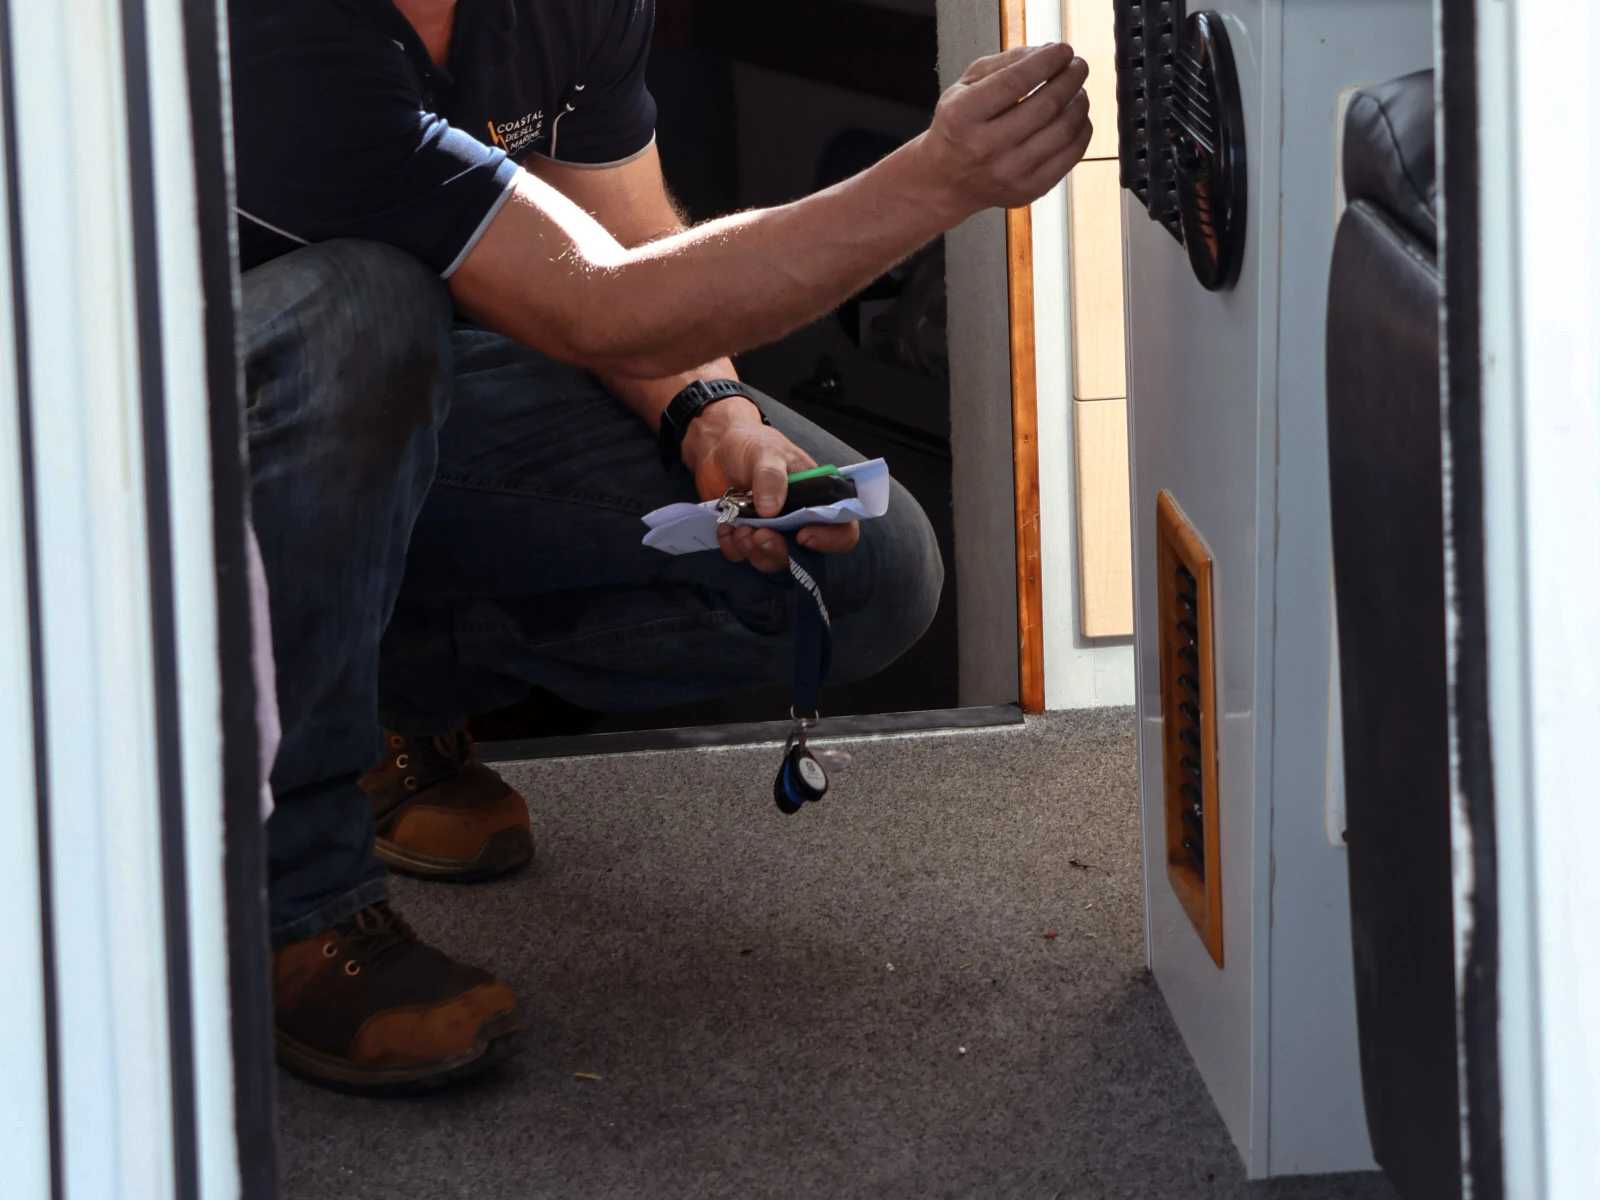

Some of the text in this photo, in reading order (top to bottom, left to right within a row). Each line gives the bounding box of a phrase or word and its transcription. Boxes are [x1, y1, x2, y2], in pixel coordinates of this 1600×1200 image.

[497, 109, 544, 134] COASTAL
[505, 124, 533, 143] DIESEL
[510, 130, 540, 150] MARINE
